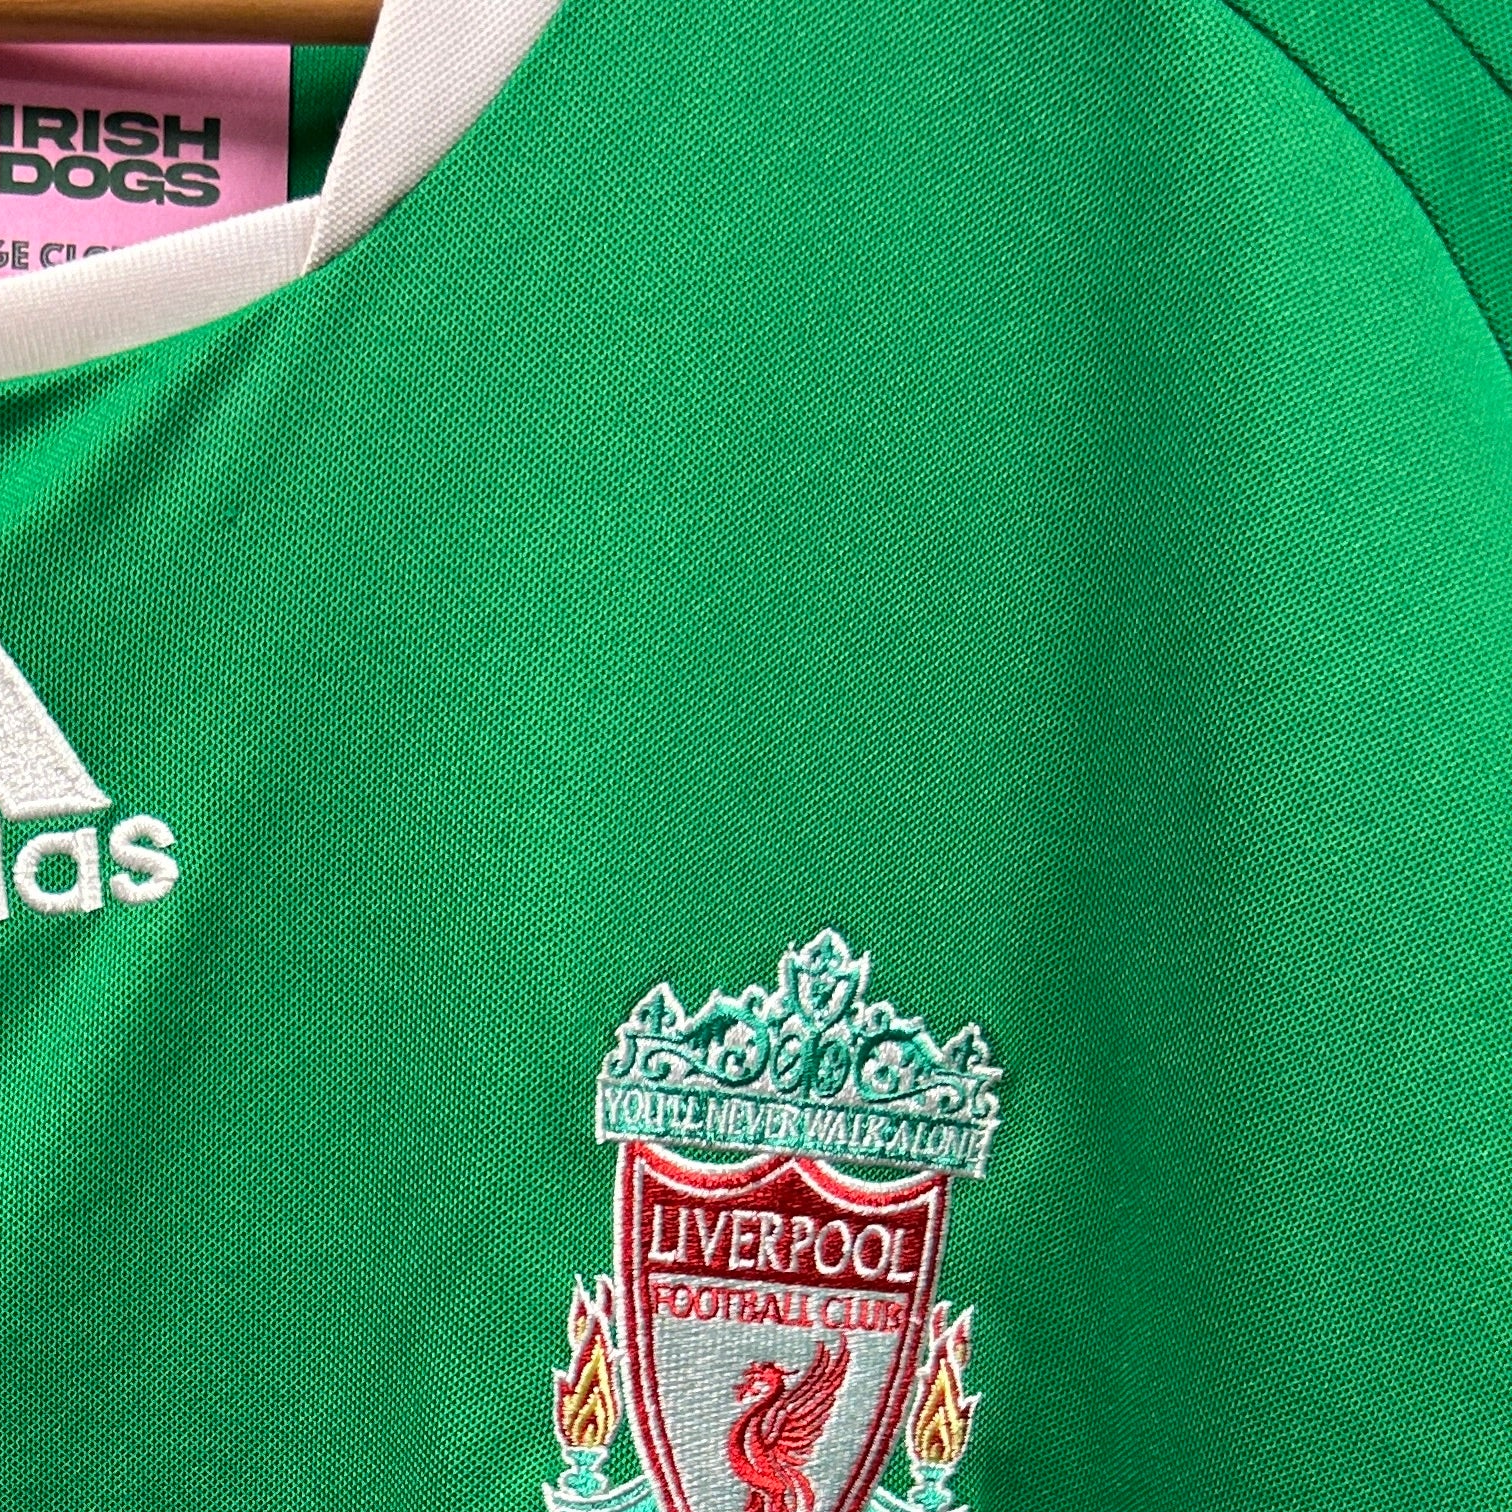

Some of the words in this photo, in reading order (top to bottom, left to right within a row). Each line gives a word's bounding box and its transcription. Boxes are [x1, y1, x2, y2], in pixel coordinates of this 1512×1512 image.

[706, 1097, 800, 1141] NEVER
[802, 1107, 886, 1149] WALK
[885, 1120, 986, 1164] ALONE
[648, 1204, 917, 1283] LIVERPOOL
[650, 1282, 815, 1328] FOOTBALL
[819, 1296, 908, 1333] CLUB
